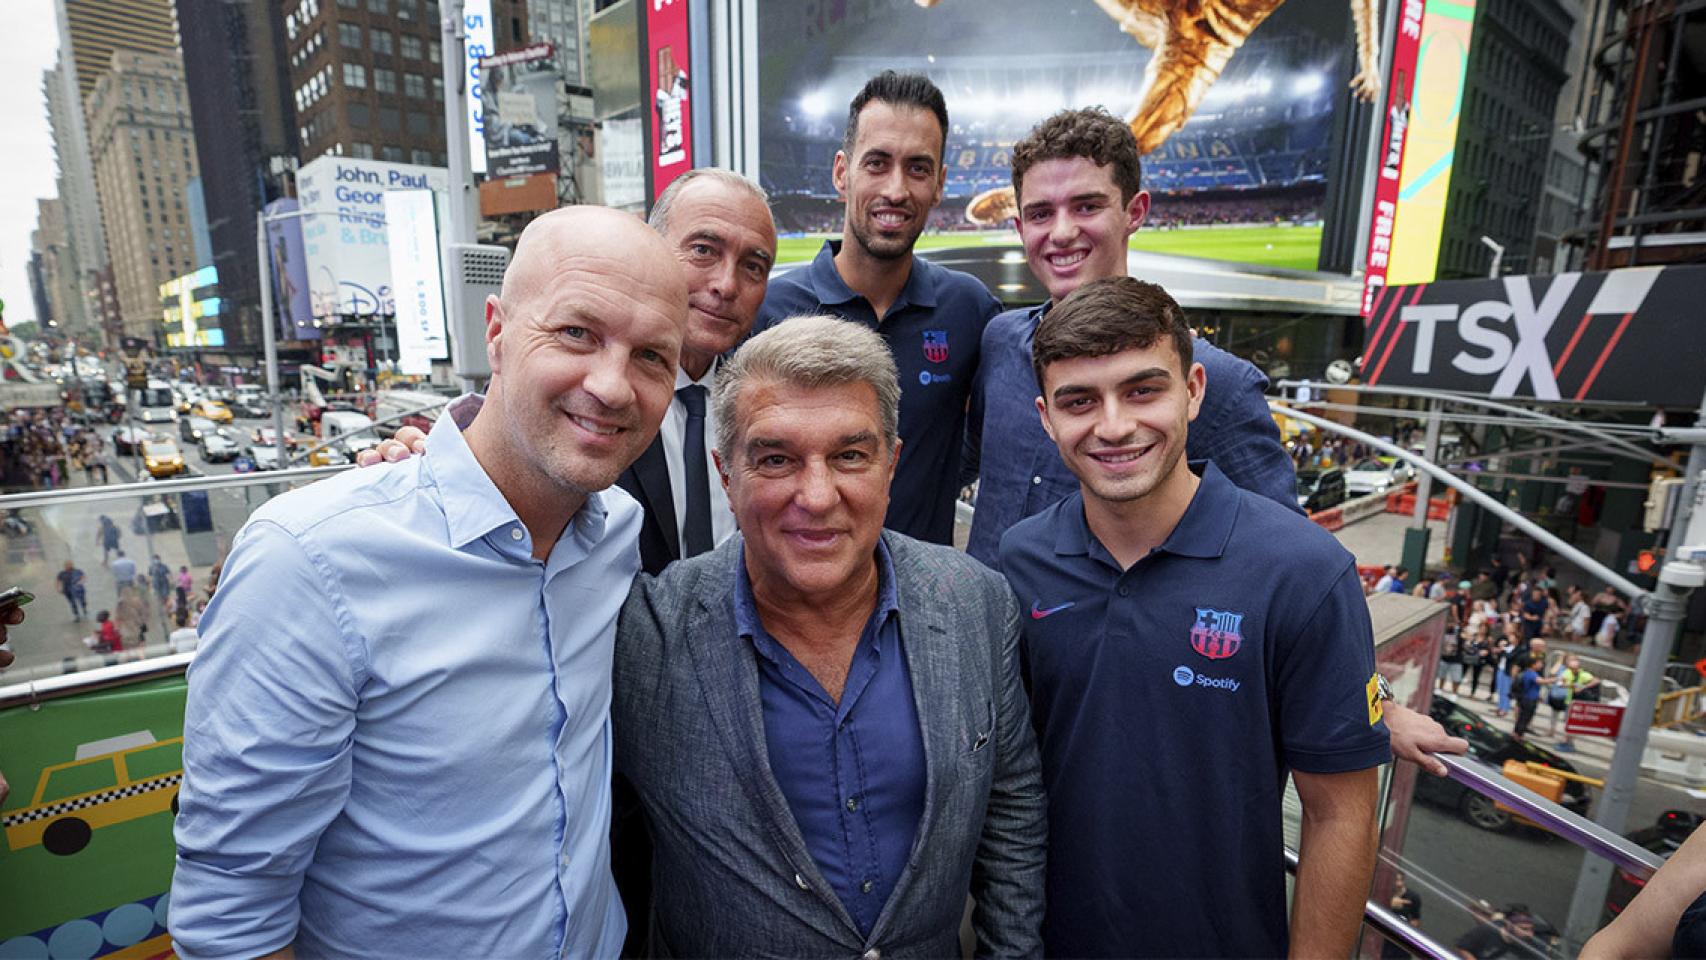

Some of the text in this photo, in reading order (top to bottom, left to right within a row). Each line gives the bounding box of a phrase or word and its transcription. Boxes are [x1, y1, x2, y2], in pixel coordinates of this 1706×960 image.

[1370, 200, 1396, 268] FREE
[1400, 272, 1582, 400] TSX
[1196, 673, 1240, 692] Spotify
